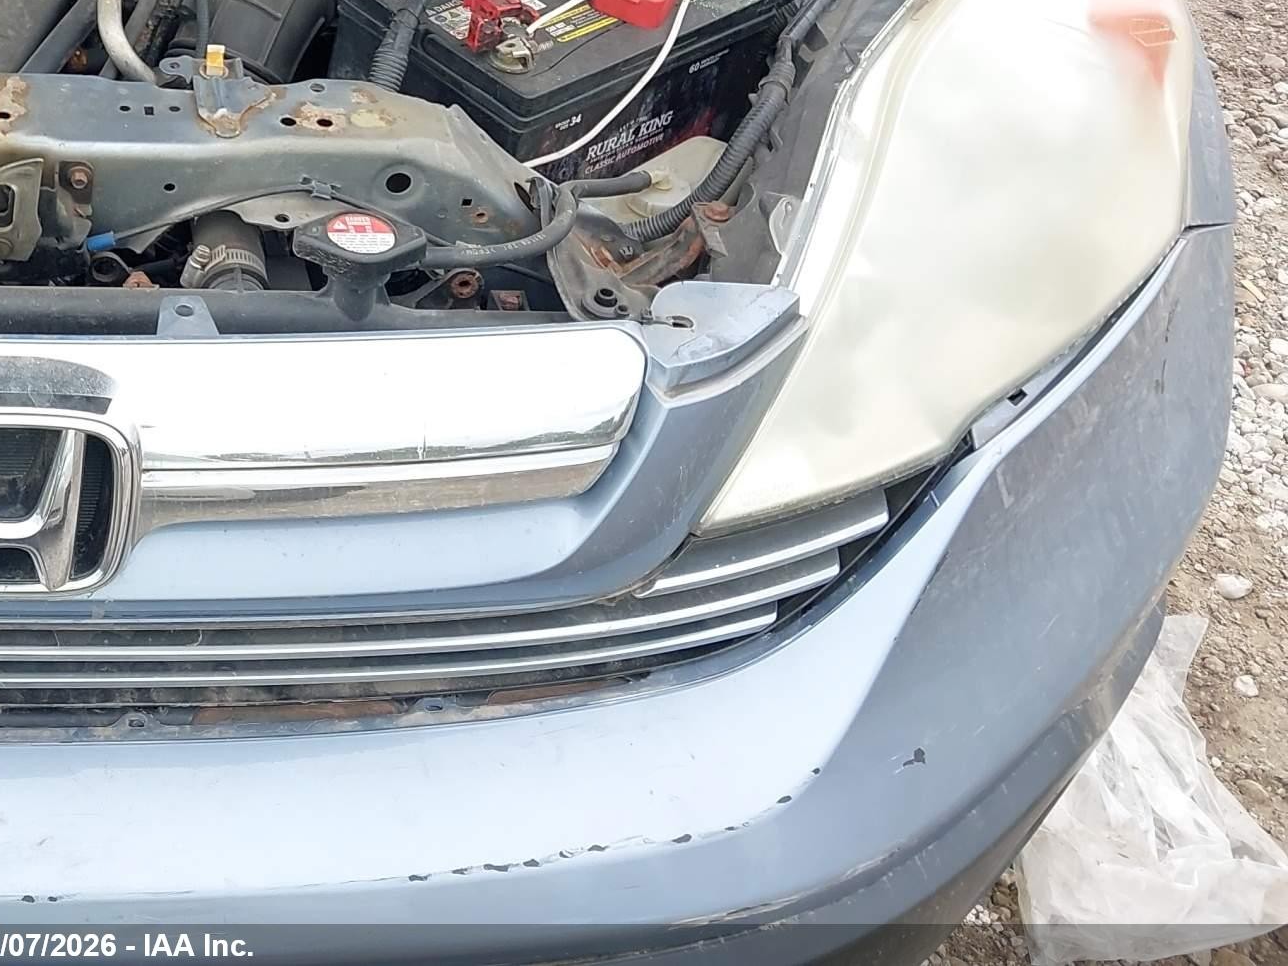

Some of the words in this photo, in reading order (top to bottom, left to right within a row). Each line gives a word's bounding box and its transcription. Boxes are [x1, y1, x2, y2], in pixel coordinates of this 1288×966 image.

[585, 126, 636, 161] RURAL
[638, 111, 674, 138] KING
[585, 155, 616, 175] CLASSIC
[616, 133, 665, 162] AUTOMOTIVE
